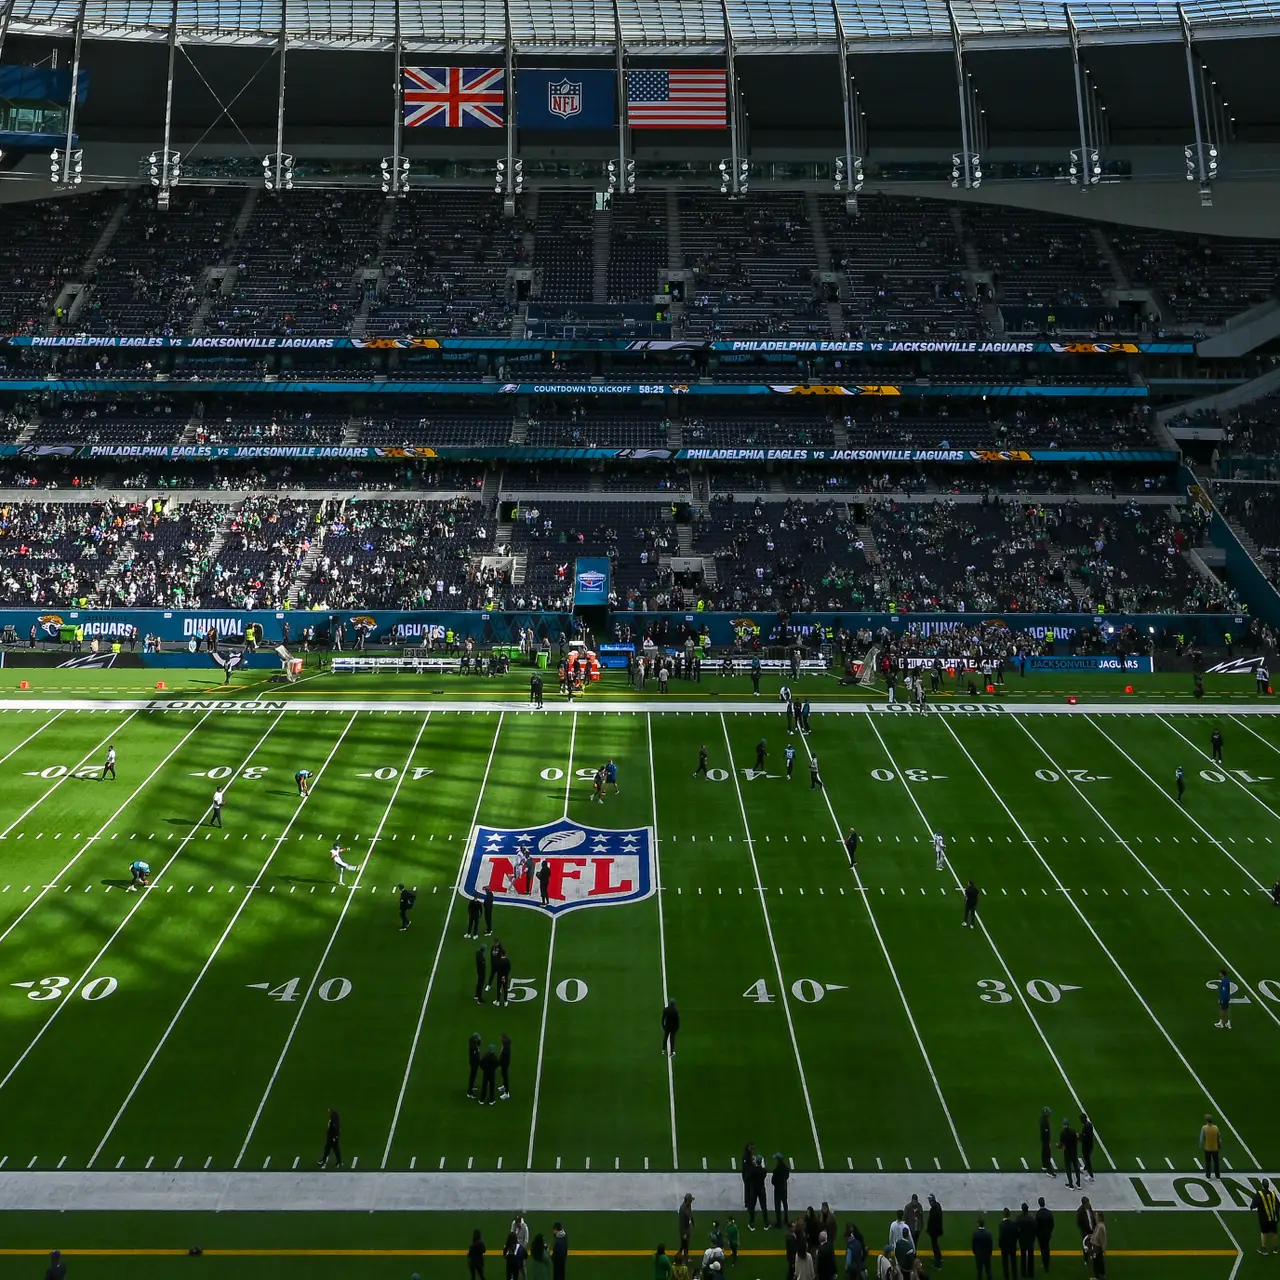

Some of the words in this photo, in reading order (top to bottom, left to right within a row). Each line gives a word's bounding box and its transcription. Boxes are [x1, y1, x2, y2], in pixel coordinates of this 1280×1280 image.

[552, 95, 579, 112] NFL
[31, 337, 116, 347] PHILADELPHIA
[120, 337, 163, 347] EAGLES
[188, 338, 275, 347] JACKSONVILLE
[278, 338, 334, 348] JAGUARS
[732, 341, 817, 351] PHILADELPHIA
[820, 342, 864, 351] EAGLES
[888, 342, 976, 352] JACKSONVILLE
[978, 343, 1034, 352] JAGUARS
[534, 385, 586, 393] COUNTDOWN
[588, 385, 597, 393] TO
[599, 385, 632, 393] KICKOFF
[639, 385, 664, 394] 58:25
[90, 446, 168, 456] PHILADELPHIA
[171, 446, 212, 456] EAGLES
[234, 446, 317, 457] JACKSONVILLE
[319, 447, 369, 457] JAGUARS
[686, 449, 766, 459] PHILADELPHIA
[767, 449, 808, 459] EAGLES
[829, 450, 911, 460] JACKSONVILLE
[913, 450, 964, 460] JAGUARS
[486, 857, 633, 901] NFL
[26, 975, 119, 1001] 30
[266, 976, 352, 1002] 40
[507, 977, 589, 1003] 50
[742, 977, 824, 1004] 40
[976, 978, 1063, 1004] 30
